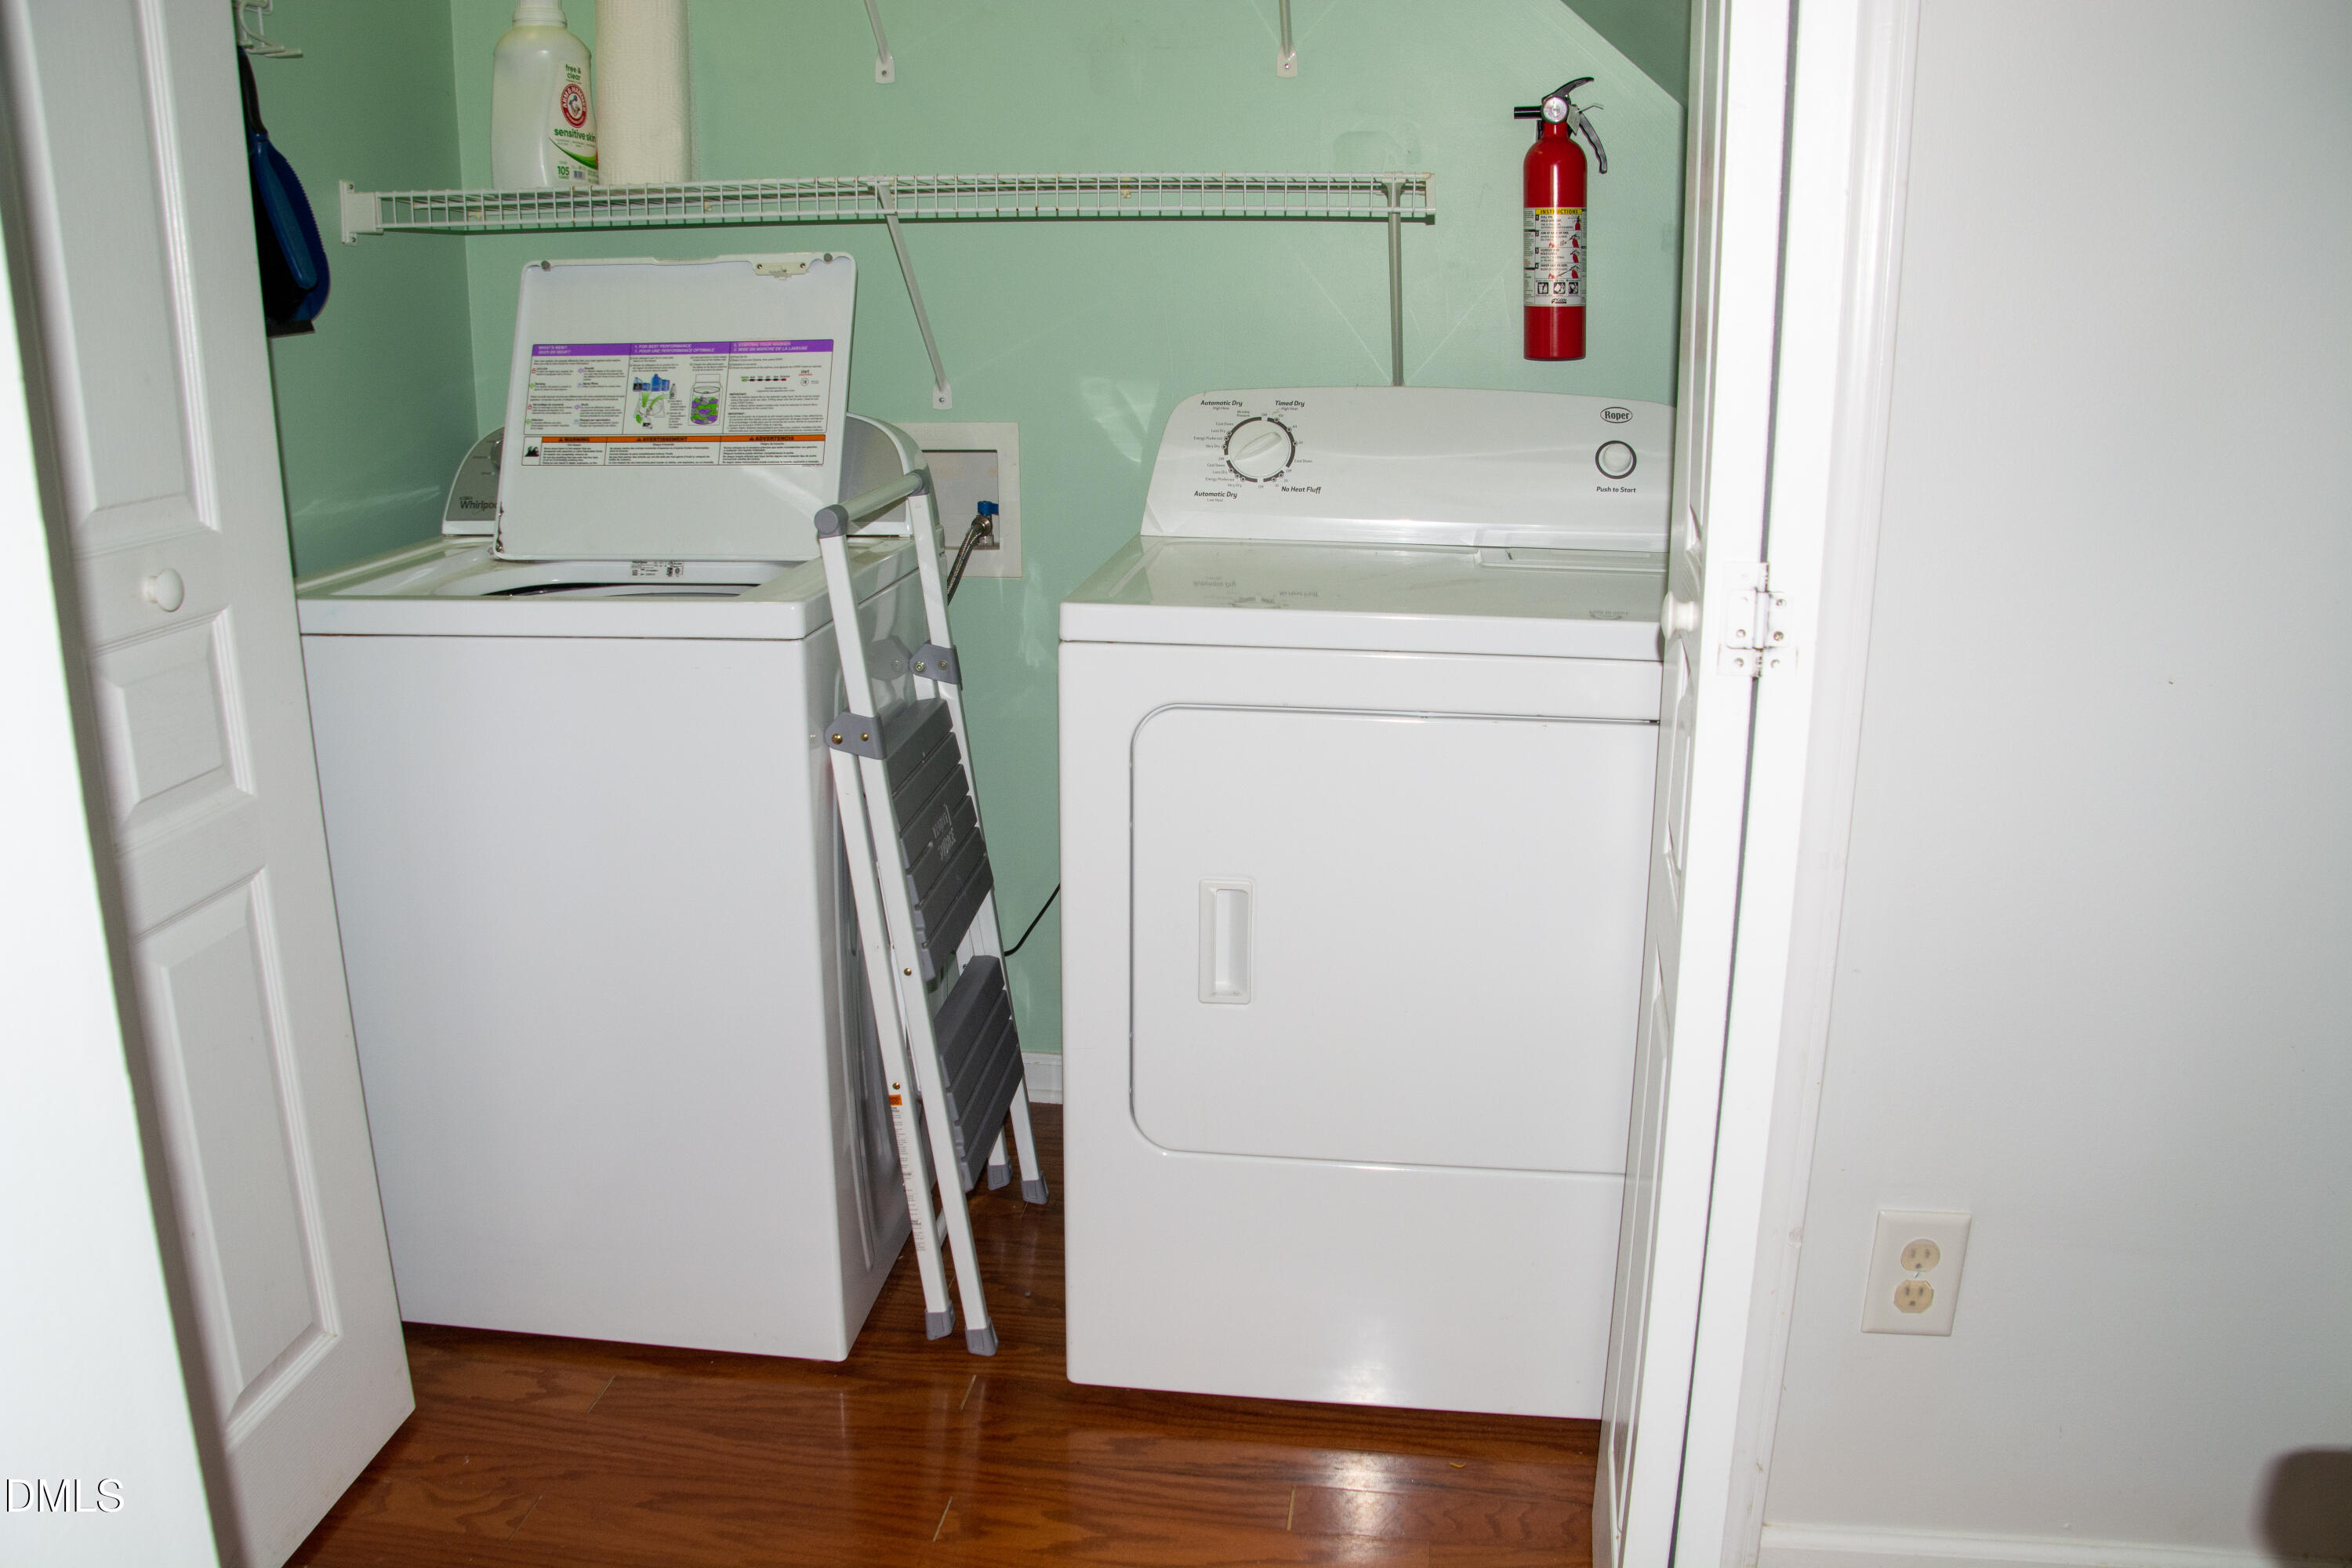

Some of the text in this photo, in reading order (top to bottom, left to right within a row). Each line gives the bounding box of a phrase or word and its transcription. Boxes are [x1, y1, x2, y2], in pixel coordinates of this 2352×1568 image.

[565, 64, 577, 73] free
[571, 86, 587, 112] HAMMER
[554, 129, 586, 140] sensitive
[557, 165, 569, 176] 105
[1604, 411, 1630, 421] Roper
[1226, 491, 1238, 499] Dry
[1306, 486, 1322, 494] Fluff
